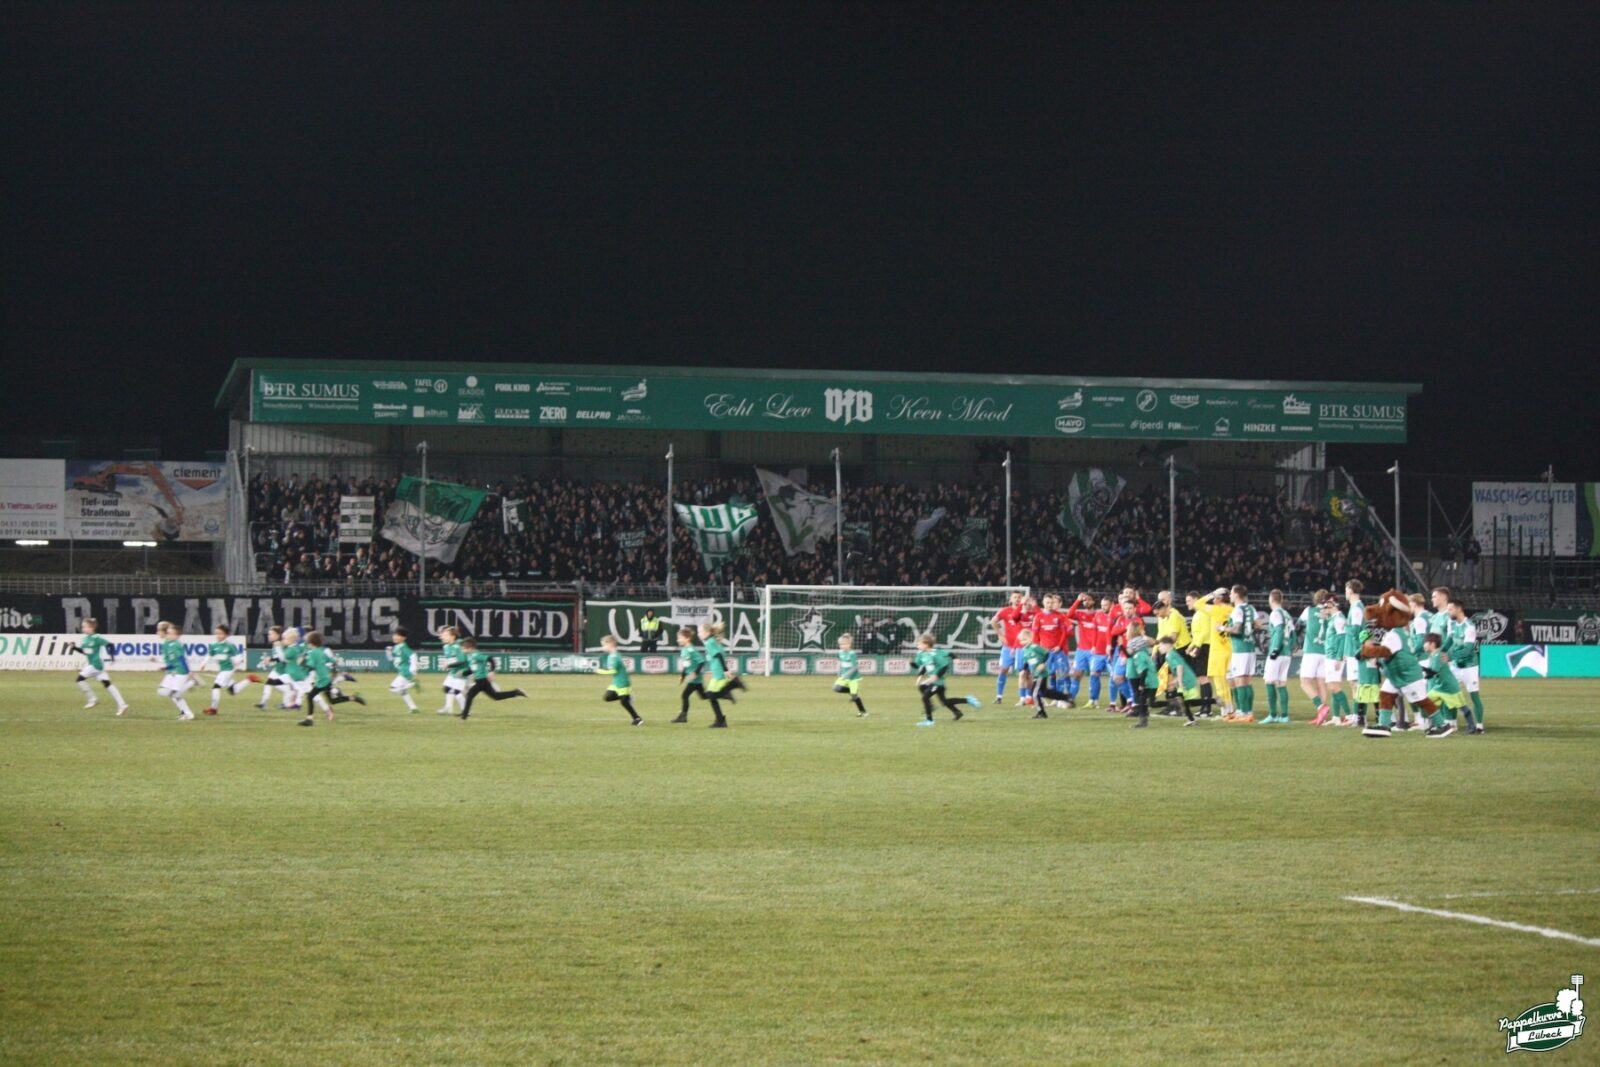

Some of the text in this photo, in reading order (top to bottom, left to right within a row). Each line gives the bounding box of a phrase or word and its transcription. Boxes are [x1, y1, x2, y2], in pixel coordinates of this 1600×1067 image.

[264, 383, 296, 396] BTR
[302, 384, 360, 397] SUMUS
[704, 392, 813, 419] Echt Leev
[824, 387, 873, 426] VfB
[886, 395, 1014, 422] Keen Mood
[1319, 404, 1348, 417] BTR
[1353, 405, 1405, 418] SUMUS
[1139, 420, 1163, 431] iperdi
[1243, 423, 1276, 432] HINZKE
[173, 467, 221, 478] clement
[81, 498, 119, 506] Tief- und
[1475, 488, 1518, 503] WASCH
[81, 507, 131, 517] Straßenbau
[0, 607, 33, 629] ide
[425, 607, 569, 638] UNITED
[1531, 625, 1576, 642] VITALIEN
[345, 659, 379, 667] HOLSTEN
